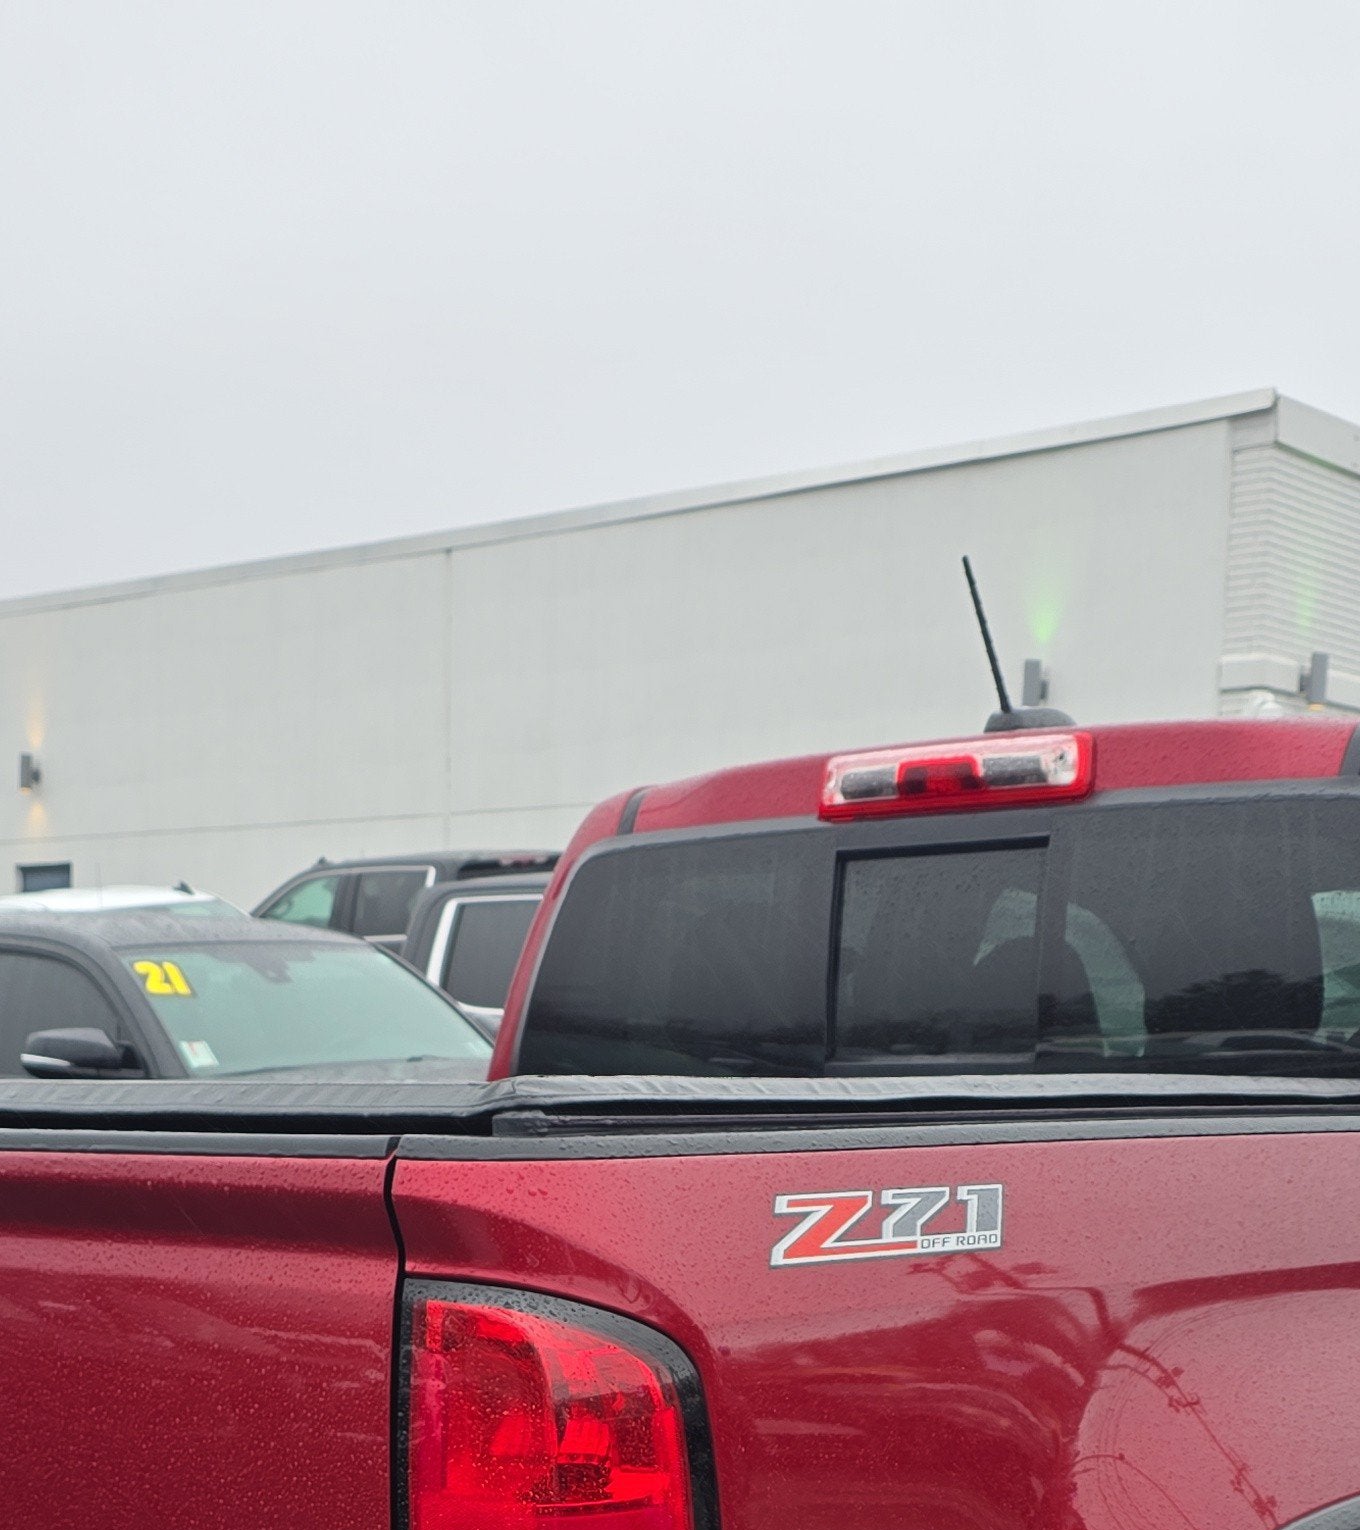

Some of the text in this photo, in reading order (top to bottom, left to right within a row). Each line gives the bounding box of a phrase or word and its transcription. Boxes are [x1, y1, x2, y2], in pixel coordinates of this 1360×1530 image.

[133, 960, 192, 995] 21
[770, 1184, 1003, 1267] Z71
[921, 1233, 998, 1249] OFF ROAD
